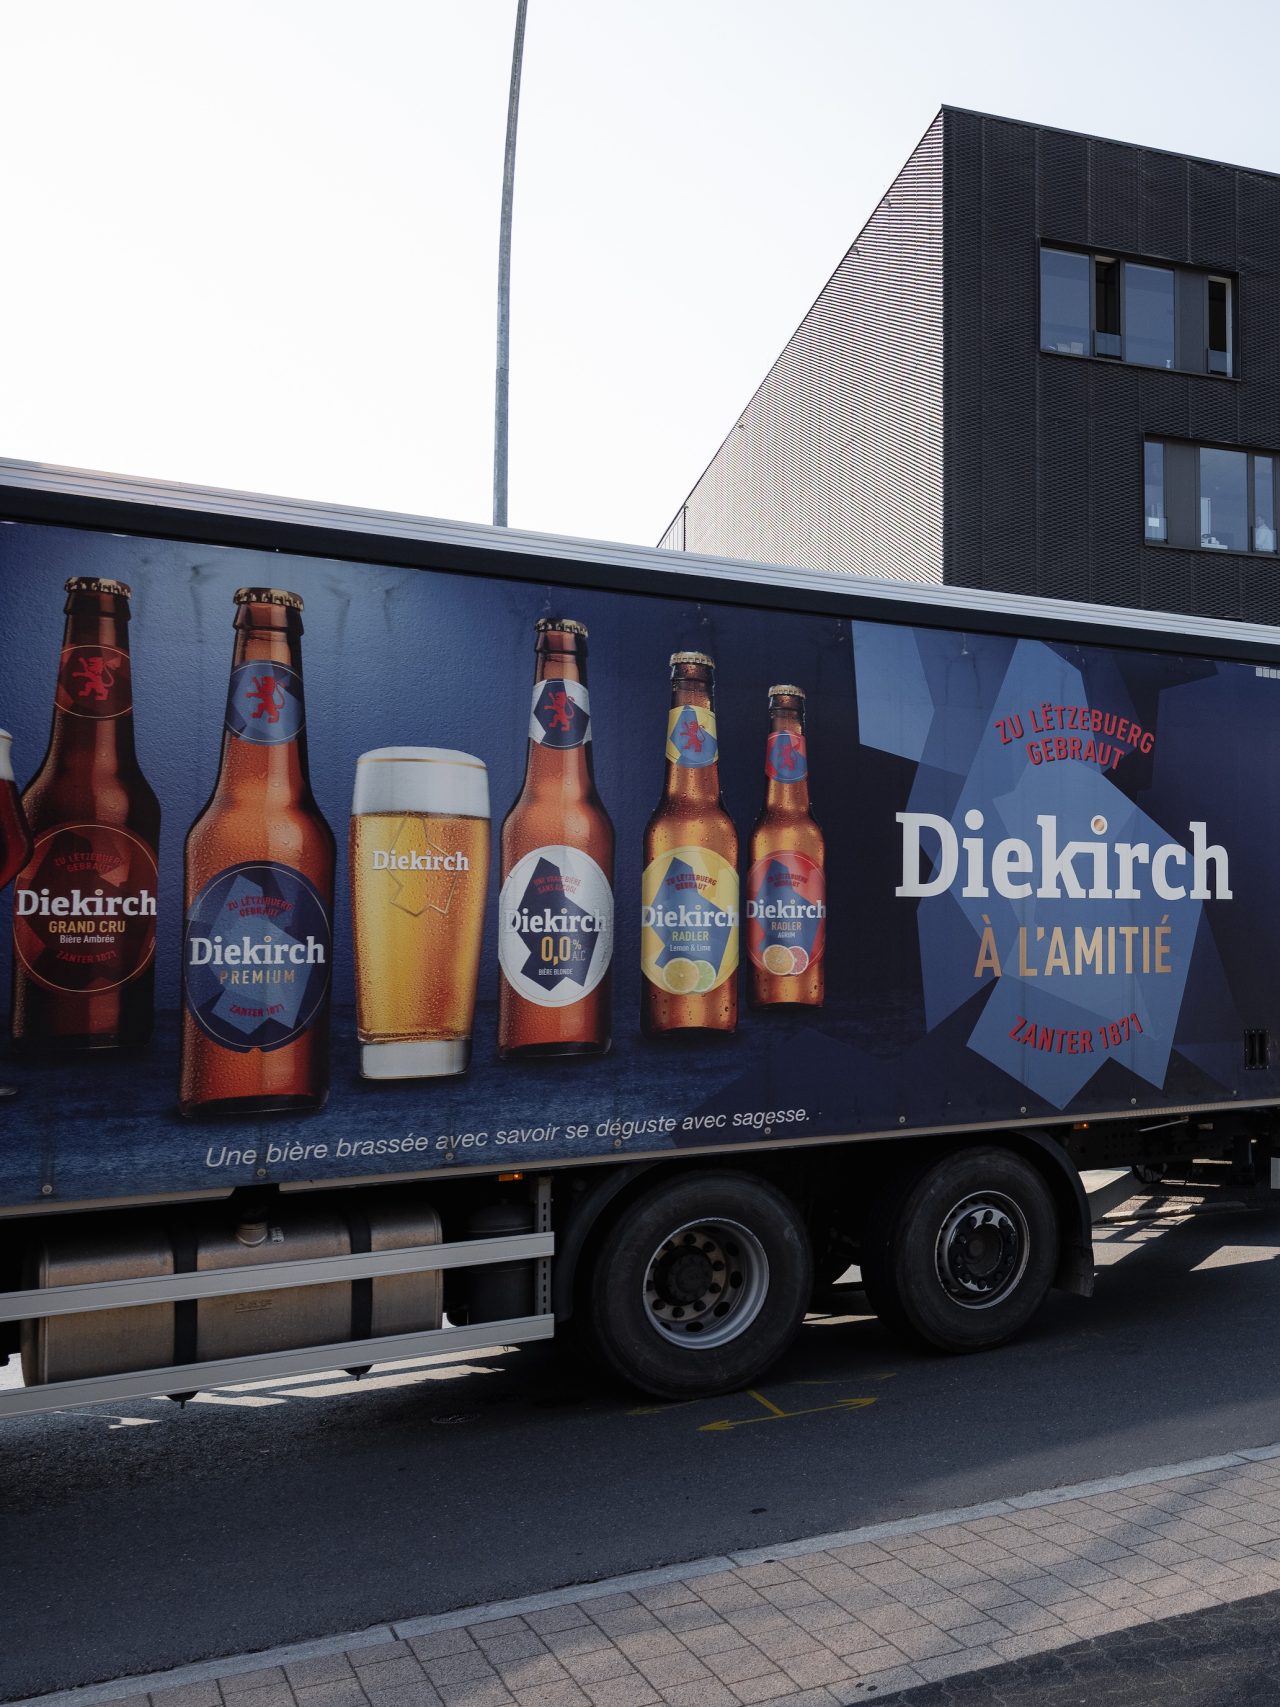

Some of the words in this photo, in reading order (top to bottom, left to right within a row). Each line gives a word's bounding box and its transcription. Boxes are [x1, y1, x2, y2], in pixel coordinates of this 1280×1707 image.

[994, 714, 1024, 745] ZU
[1028, 703, 1155, 755] LËTZEBUERG
[1025, 736, 1124, 770] GEBRAUT
[372, 850, 469, 871] Diekirch
[895, 809, 1233, 900] Diekirch
[16, 889, 157, 917] Diekirch
[746, 899, 826, 919] Diekirch
[49, 921, 95, 933] GRAND
[99, 920, 126, 933] CRU
[503, 908, 607, 933] Diekirch
[641, 905, 739, 928] Diekirch
[771, 921, 802, 931] RADLER
[60, 934, 82, 944] Bière
[83, 934, 115, 944] Ambrée
[672, 931, 709, 942] RADLER
[974, 914, 1002, 978] À
[1019, 914, 1172, 976] L'AMITIÉ
[189, 935, 325, 965] Diekirch
[220, 970, 296, 985] PREMIUM
[1008, 1016, 1093, 1055] ZANTER
[1099, 1012, 1143, 1050] 1871
[205, 1147, 257, 1167] Une
[265, 1141, 328, 1163] bière
[336, 1133, 428, 1157] brassée
[435, 1130, 488, 1150] avec
[495, 1123, 559, 1145] savoir
[565, 1124, 589, 1139] se
[595, 1115, 677, 1140] déguste
[682, 1114, 727, 1131] avec
[732, 1107, 811, 1129] sagesse.
